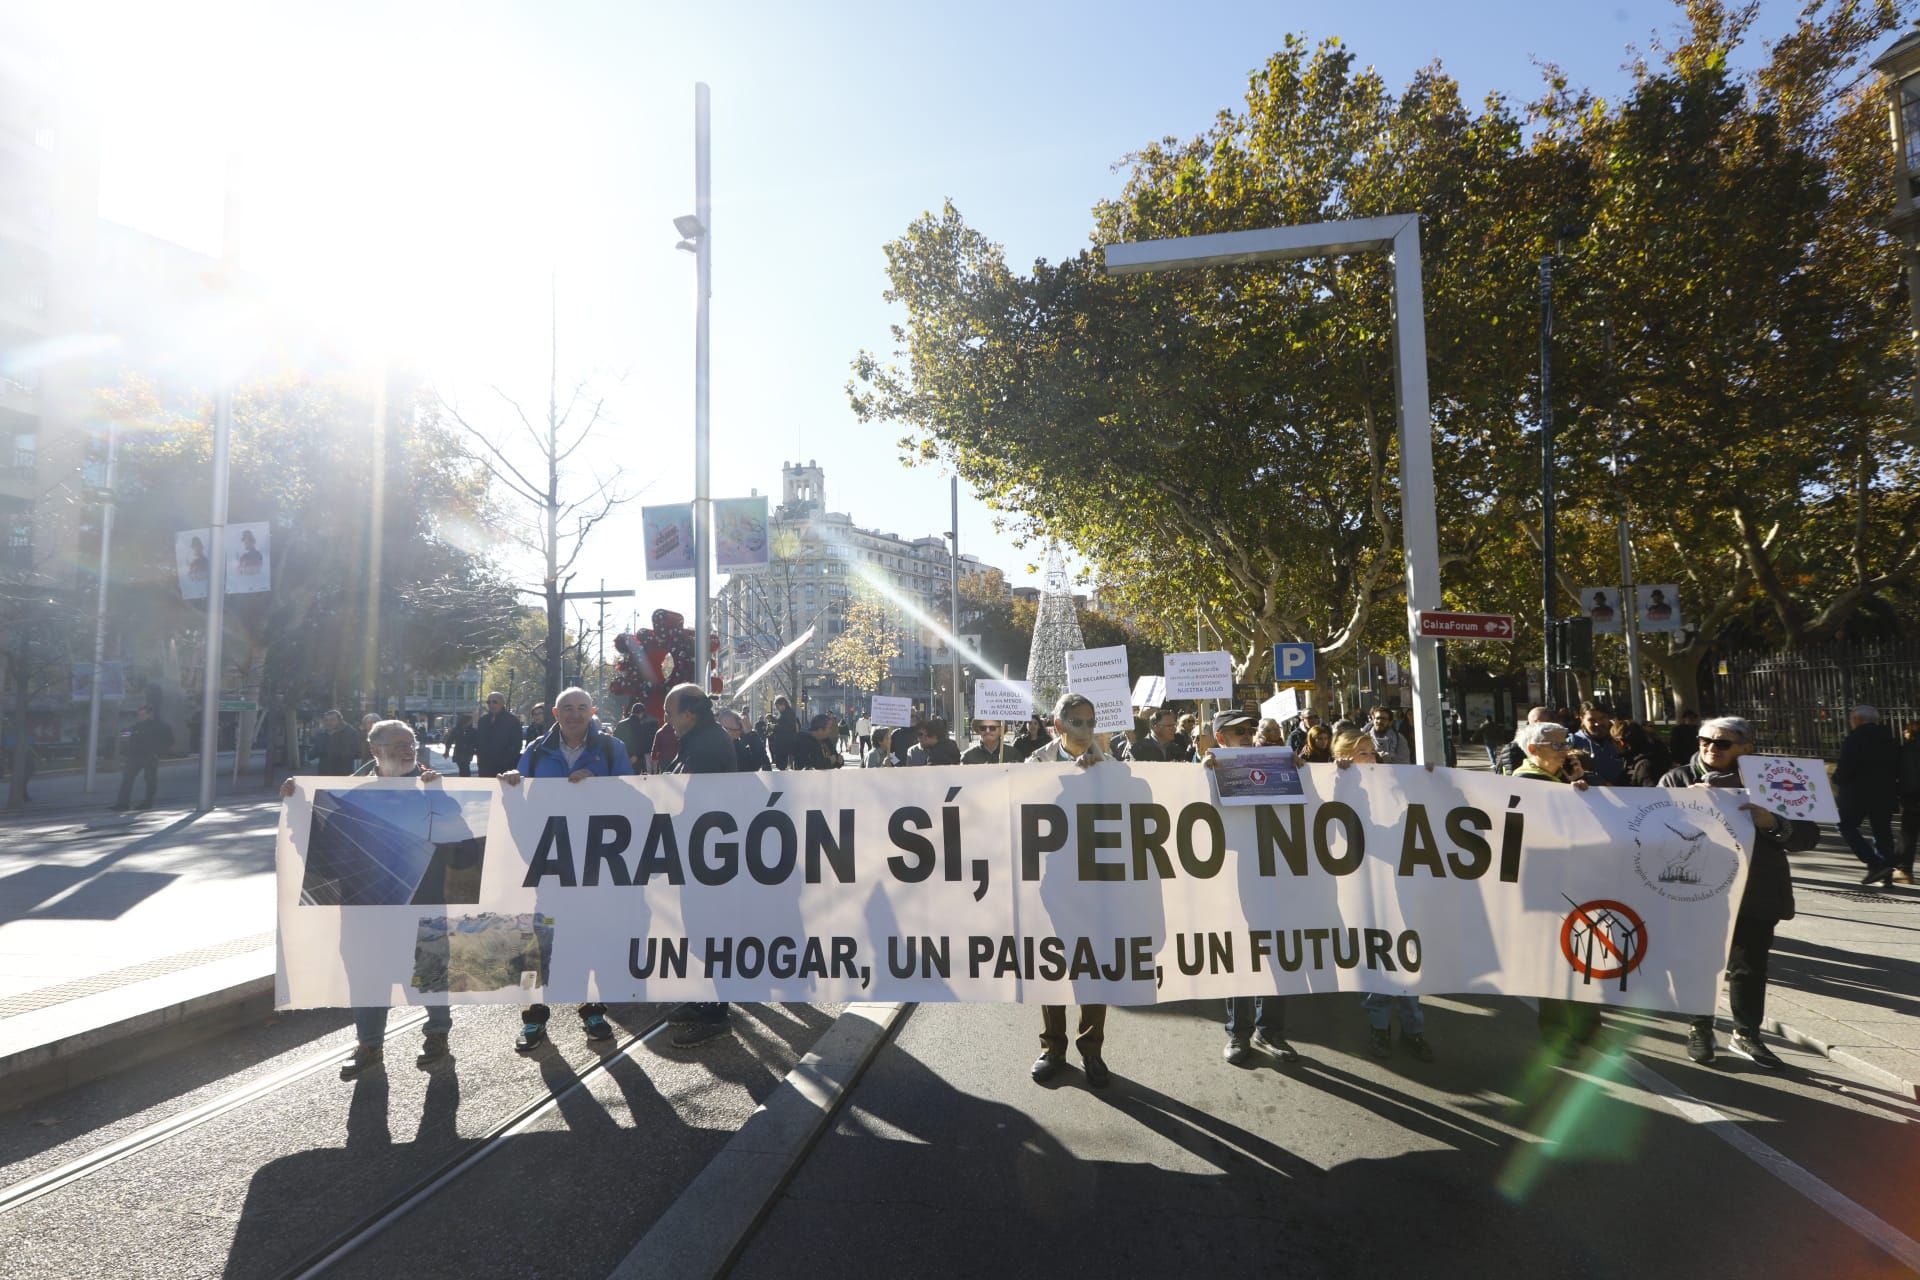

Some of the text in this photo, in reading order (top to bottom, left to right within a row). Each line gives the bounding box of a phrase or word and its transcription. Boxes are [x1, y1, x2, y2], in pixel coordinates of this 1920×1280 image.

[1423, 620, 1478, 631] CaixaForum
[1283, 647, 1307, 676] P
[1098, 719, 1127, 728] CIUDADES
[1771, 766, 1808, 785] DEFIENDO
[1773, 792, 1809, 807] LA HUERTA
[1628, 800, 1672, 832] Plataforma
[1688, 800, 1704, 811] de
[522, 786, 990, 903] ARAGÓN SÍ,
[1020, 795, 1525, 883] PERO NO ASÍ
[627, 927, 1422, 990] UN HOGAR, UN PAISAJE, UN FUTURO
